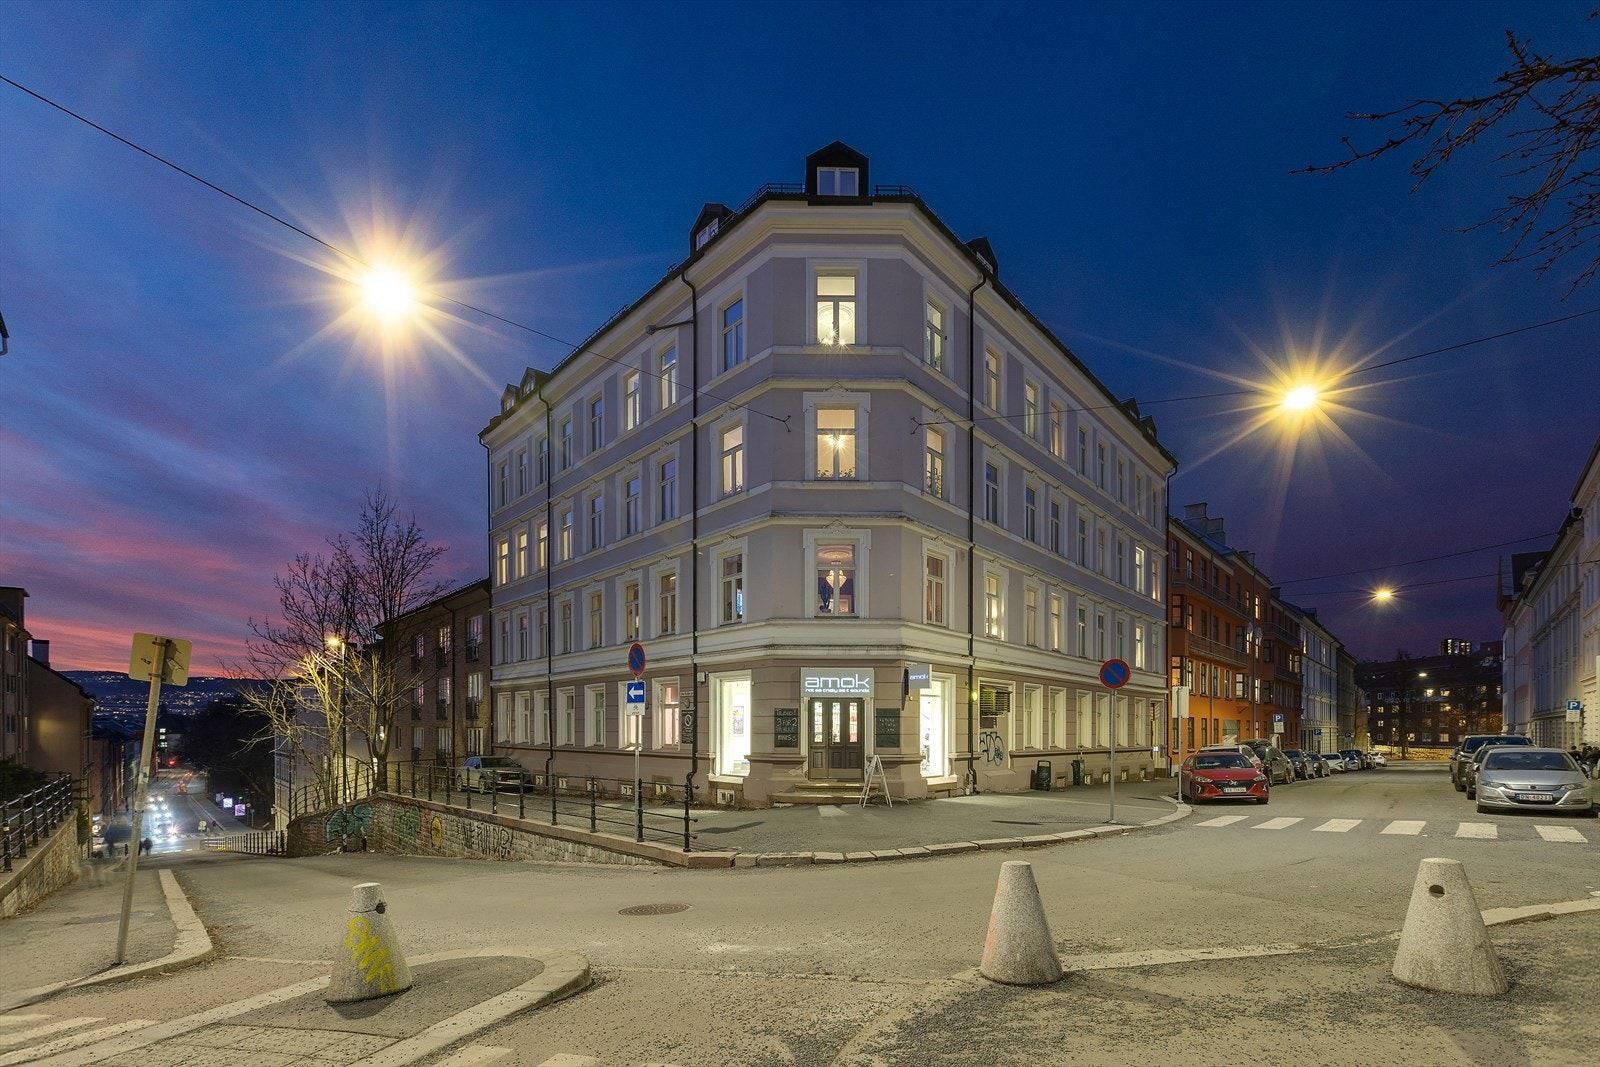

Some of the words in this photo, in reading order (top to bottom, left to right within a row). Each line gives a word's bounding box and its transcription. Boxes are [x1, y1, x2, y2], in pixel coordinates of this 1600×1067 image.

[805, 673, 870, 688] amok
[776, 717, 782, 727] 3
[791, 717, 798, 727] 2
